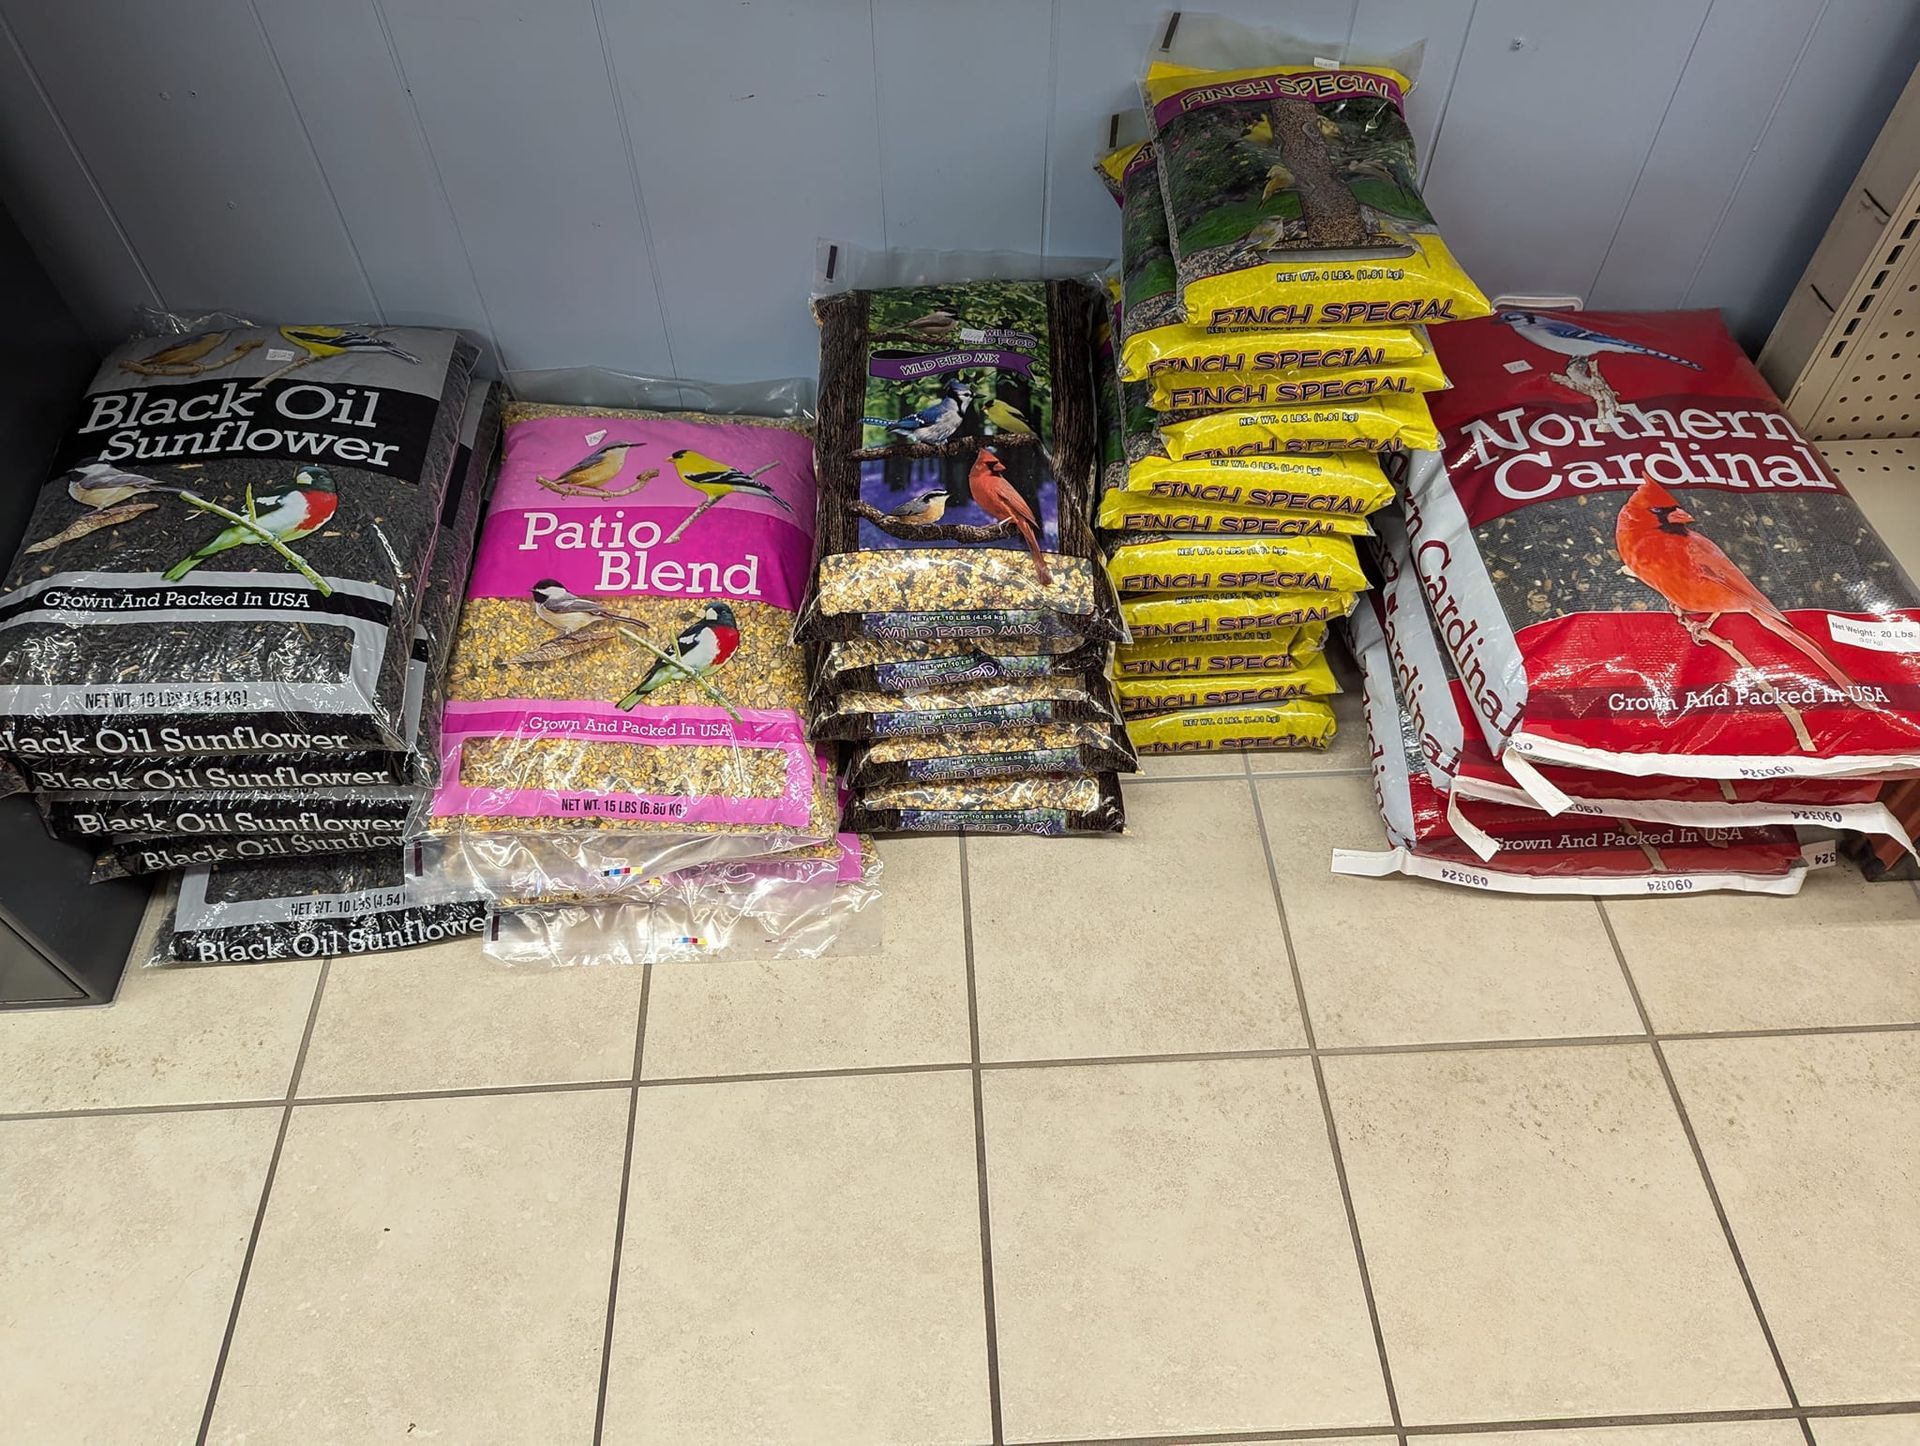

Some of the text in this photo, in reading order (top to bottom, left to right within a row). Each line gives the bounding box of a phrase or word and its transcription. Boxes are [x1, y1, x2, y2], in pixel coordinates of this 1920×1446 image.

[1180, 74, 1398, 111] FINCH SPECIAL
[1277, 269, 1404, 282] NET WT. 4 LBS. (1.81 kg)
[1210, 299, 1457, 326] FINCH SPECIAL
[998, 337, 1036, 348] FOOD
[900, 352, 1000, 375] WILD BIRD MIX
[1148, 348, 1385, 377] FINCH SPECIAL
[1170, 376, 1415, 407] FINCH SPECIAL
[78, 382, 380, 434] Black Oil
[1239, 412, 1359, 426] NET WT. 4 LBS. (1.81 kg)
[97, 420, 399, 466] Sunflower
[1460, 403, 1807, 470] Northern
[1211, 459, 1229, 467] NET
[1231, 460, 1249, 468] WT.
[1260, 462, 1279, 470] LBS.
[1306, 466, 1322, 476] kg)
[1494, 441, 1838, 500] Cardinal
[1150, 481, 1367, 514] FINCH SPECIAL
[518, 510, 661, 552] Patio
[1123, 513, 1336, 535] FINCH SPECIAL
[1177, 547, 1195, 556] NET
[594, 550, 761, 596] Blend
[1122, 570, 1338, 592] FINCH SPECIAL
[43, 591, 310, 609] Grown And Packed In USA
[875, 621, 1043, 639] WILD BIRD MIX
[1832, 621, 1917, 638] Net Weight: 20 Lbs.
[1207, 654, 1292, 671] SPECI
[886, 675, 942, 690] WILD
[944, 662, 998, 683] BIRD
[85, 693, 111, 709] NET
[113, 692, 134, 708] WT.
[1608, 692, 1678, 712] Grown
[1684, 689, 1729, 708] And
[1735, 687, 1816, 706] Packed
[1848, 686, 1890, 704] USA
[529, 716, 731, 737] Grown And Packed In USA
[1183, 719, 1198, 727] NET
[1200, 718, 1215, 726] WT.
[95, 728, 157, 754] Oil
[159, 727, 348, 753] Sunflower
[32, 766, 389, 791] Black Oil Sunflower
[561, 798, 581, 812] NET
[583, 799, 600, 813] WT.
[604, 800, 615, 812] 15
[619, 801, 637, 814] LBS
[640, 801, 666, 815] (6.80
[1791, 808, 1843, 823] 090324
[74, 812, 405, 834] Black Oil Sunflower
[1557, 834, 1599, 849] And
[1602, 831, 1675, 847] Packed
[1679, 828, 1698, 843] In
[1703, 826, 1744, 842] USA
[140, 831, 406, 870] Black Oil Sunflow
[1441, 867, 1489, 886] 090324
[1648, 878, 1693, 892] 090324
[290, 902, 312, 916] NET
[337, 901, 350, 913] 10
[373, 894, 401, 910] (4.54
[199, 916, 486, 964] Black Oil Sunflowe
